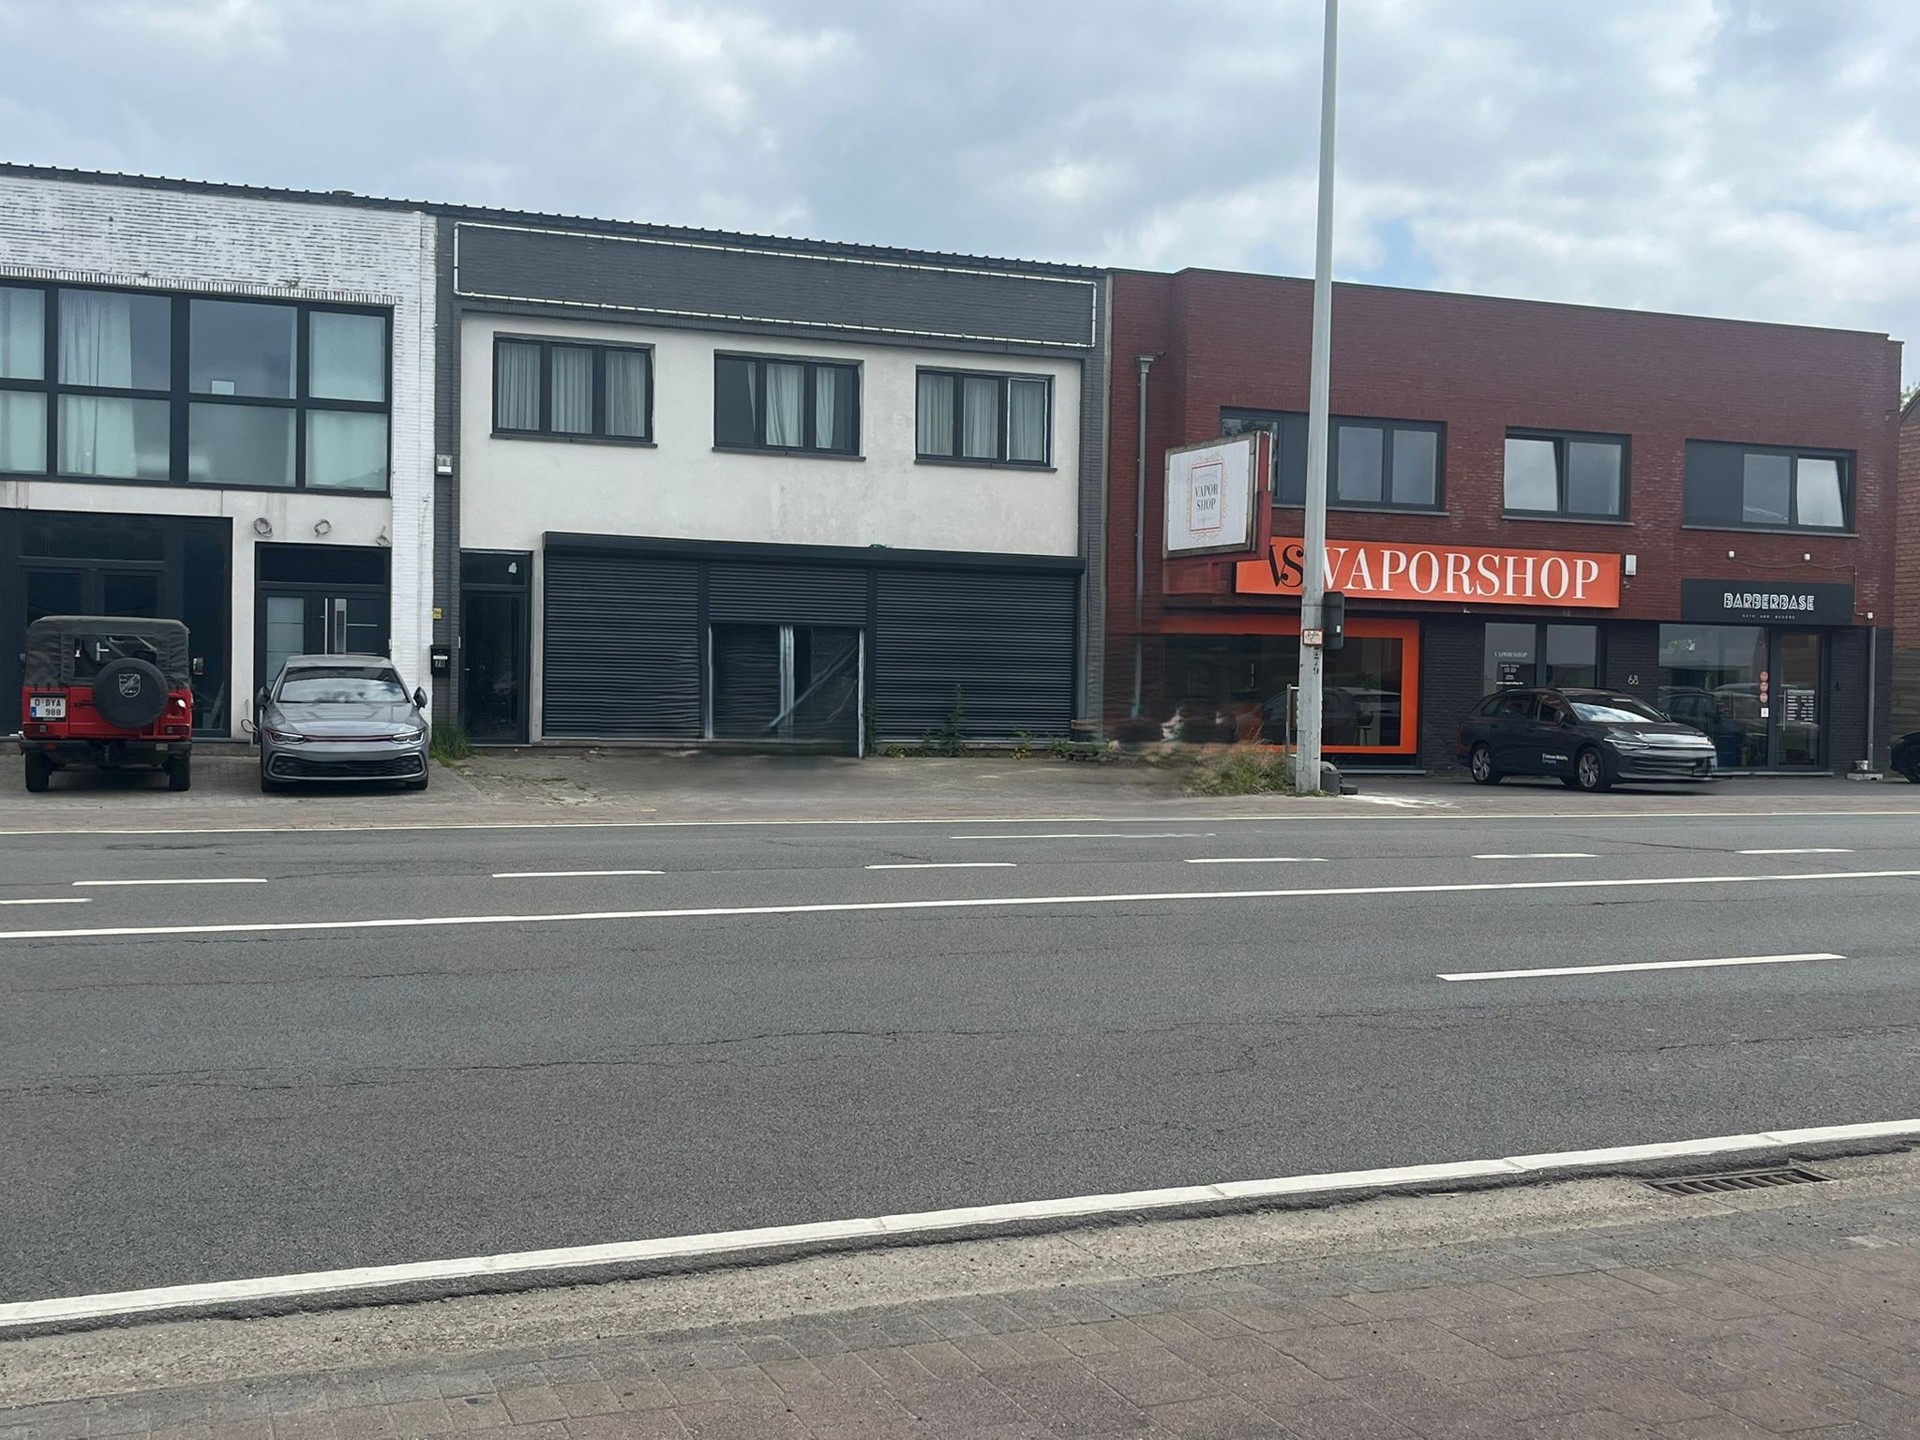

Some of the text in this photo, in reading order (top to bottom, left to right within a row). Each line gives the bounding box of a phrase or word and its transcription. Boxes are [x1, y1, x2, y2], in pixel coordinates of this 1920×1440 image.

[1195, 483, 1219, 498] VAPOR
[1196, 498, 1217, 512] SHOP
[1324, 547, 1599, 600] VAPORSHOP
[1723, 592, 1815, 611] BARBERBASE
[1627, 674, 1639, 686] 68
[45, 708, 62, 716] 988
